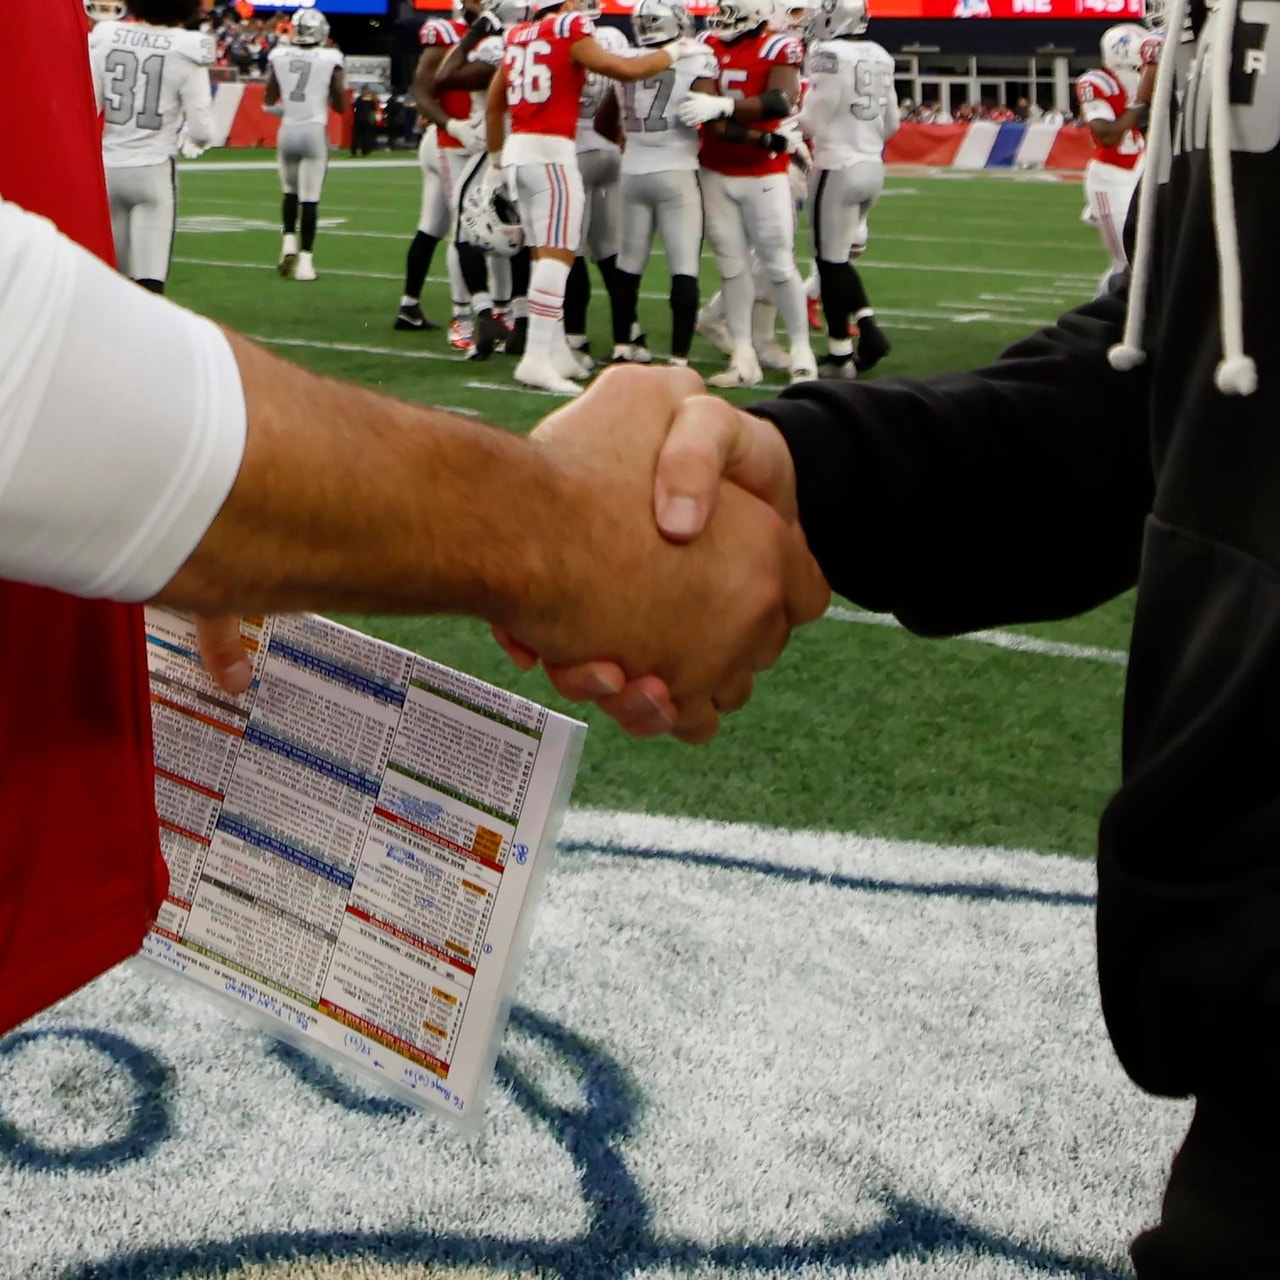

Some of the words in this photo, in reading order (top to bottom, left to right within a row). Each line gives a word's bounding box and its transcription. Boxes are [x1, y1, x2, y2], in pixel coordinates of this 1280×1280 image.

[111, 27, 173, 51] STOKES
[103, 48, 166, 131] 31
[288, 59, 313, 103] 7
[504, 38, 553, 107] 36
